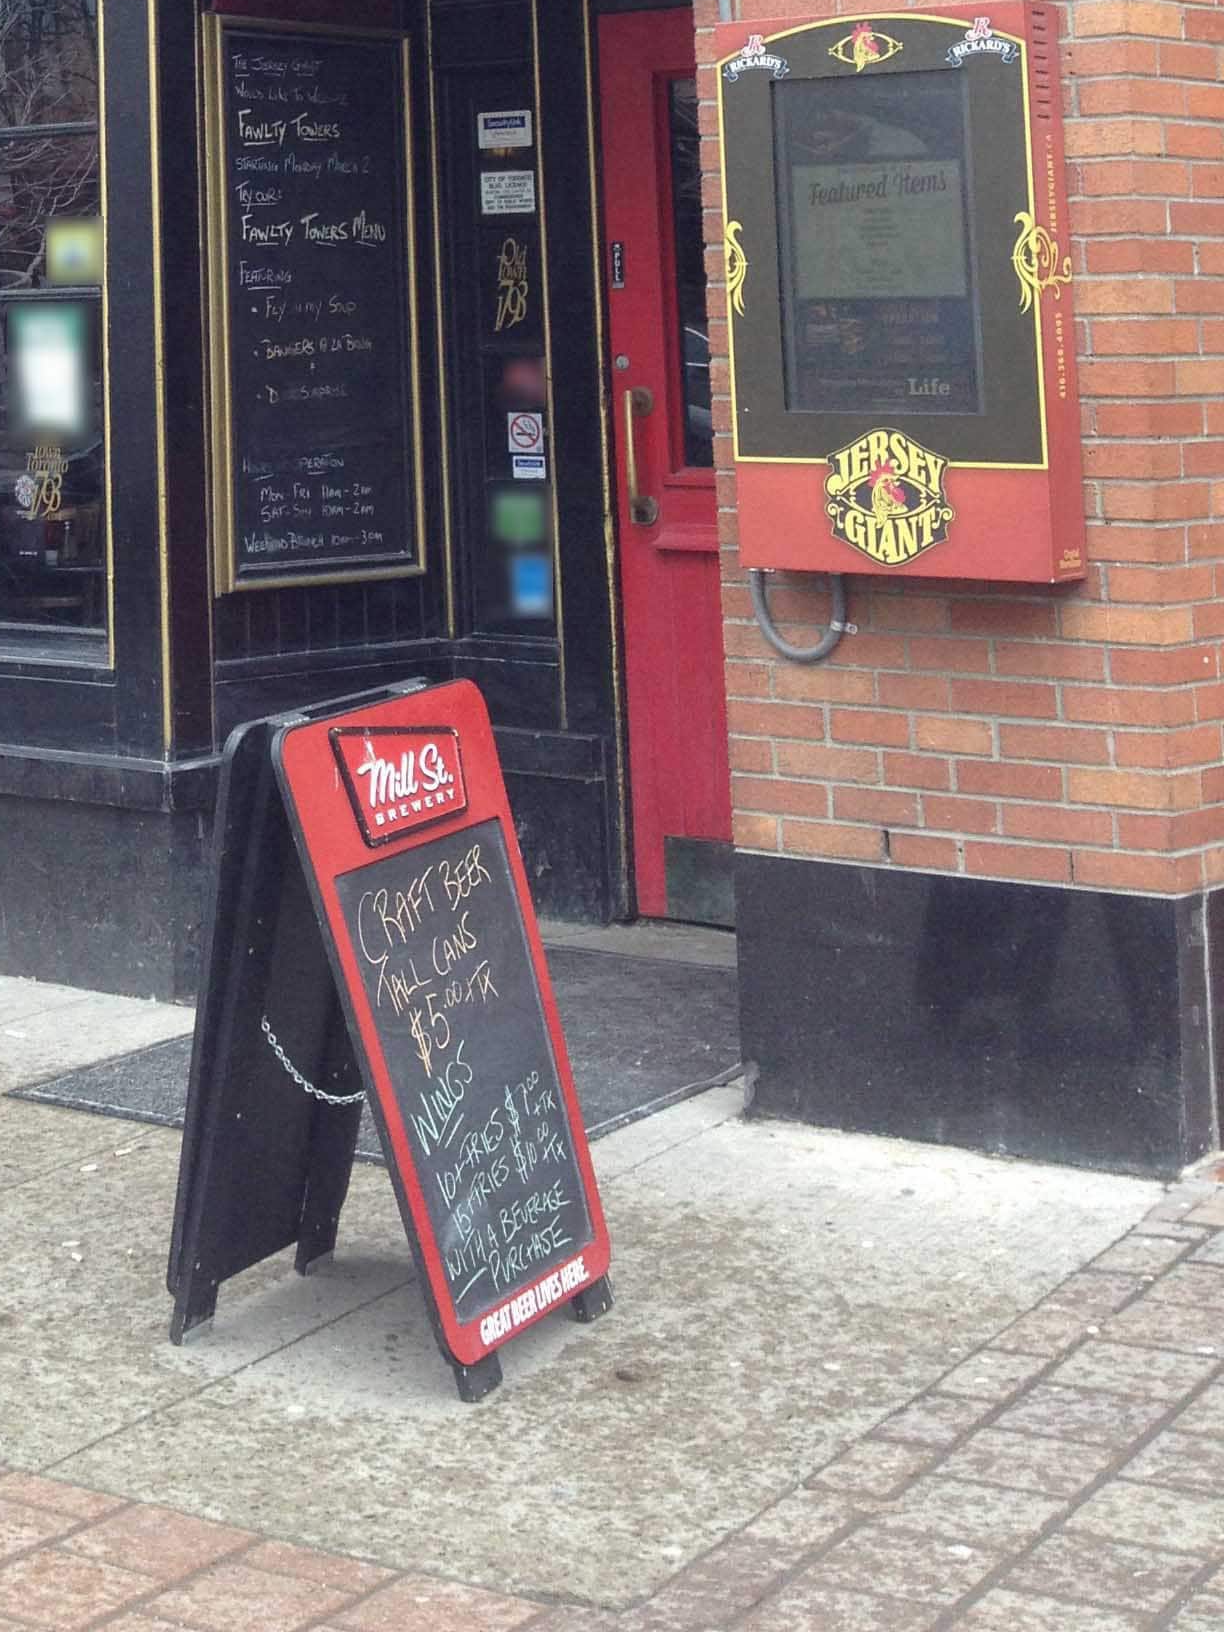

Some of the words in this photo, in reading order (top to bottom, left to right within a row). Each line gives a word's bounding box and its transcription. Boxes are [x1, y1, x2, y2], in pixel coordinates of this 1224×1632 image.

[728, 55, 783, 73] RICKARD'S
[952, 39, 1011, 58] RICKARD'S
[238, 108, 287, 146] FAWLTY
[290, 112, 341, 138] TOWERS
[235, 180, 253, 213] TRY
[808, 172, 889, 206] Featured
[891, 169, 947, 197] Items
[240, 214, 294, 247] FAWLTY
[299, 213, 349, 240] TOWERS
[352, 209, 386, 241] MENU
[907, 376, 951, 397] Life
[827, 430, 944, 496] JERSEY
[844, 506, 937, 564] GIANT
[356, 751, 419, 808] Mill
[419, 743, 454, 792] St.
[374, 787, 456, 826] BREWERY
[357, 864, 435, 965] CRAFT
[438, 843, 493, 912] BEER
[376, 948, 432, 1016] TALL
[432, 910, 478, 976] CANS
[409, 1039, 474, 1156] WINGS
[444, 1227, 489, 1281] WITH
[486, 1223, 500, 1249] A
[498, 1179, 572, 1245] BEVERAGE
[487, 1214, 574, 1294] PURCHASE
[479, 1302, 513, 1347] GREAT
[510, 1288, 539, 1327] BEER
[534, 1271, 564, 1311] LIVES
